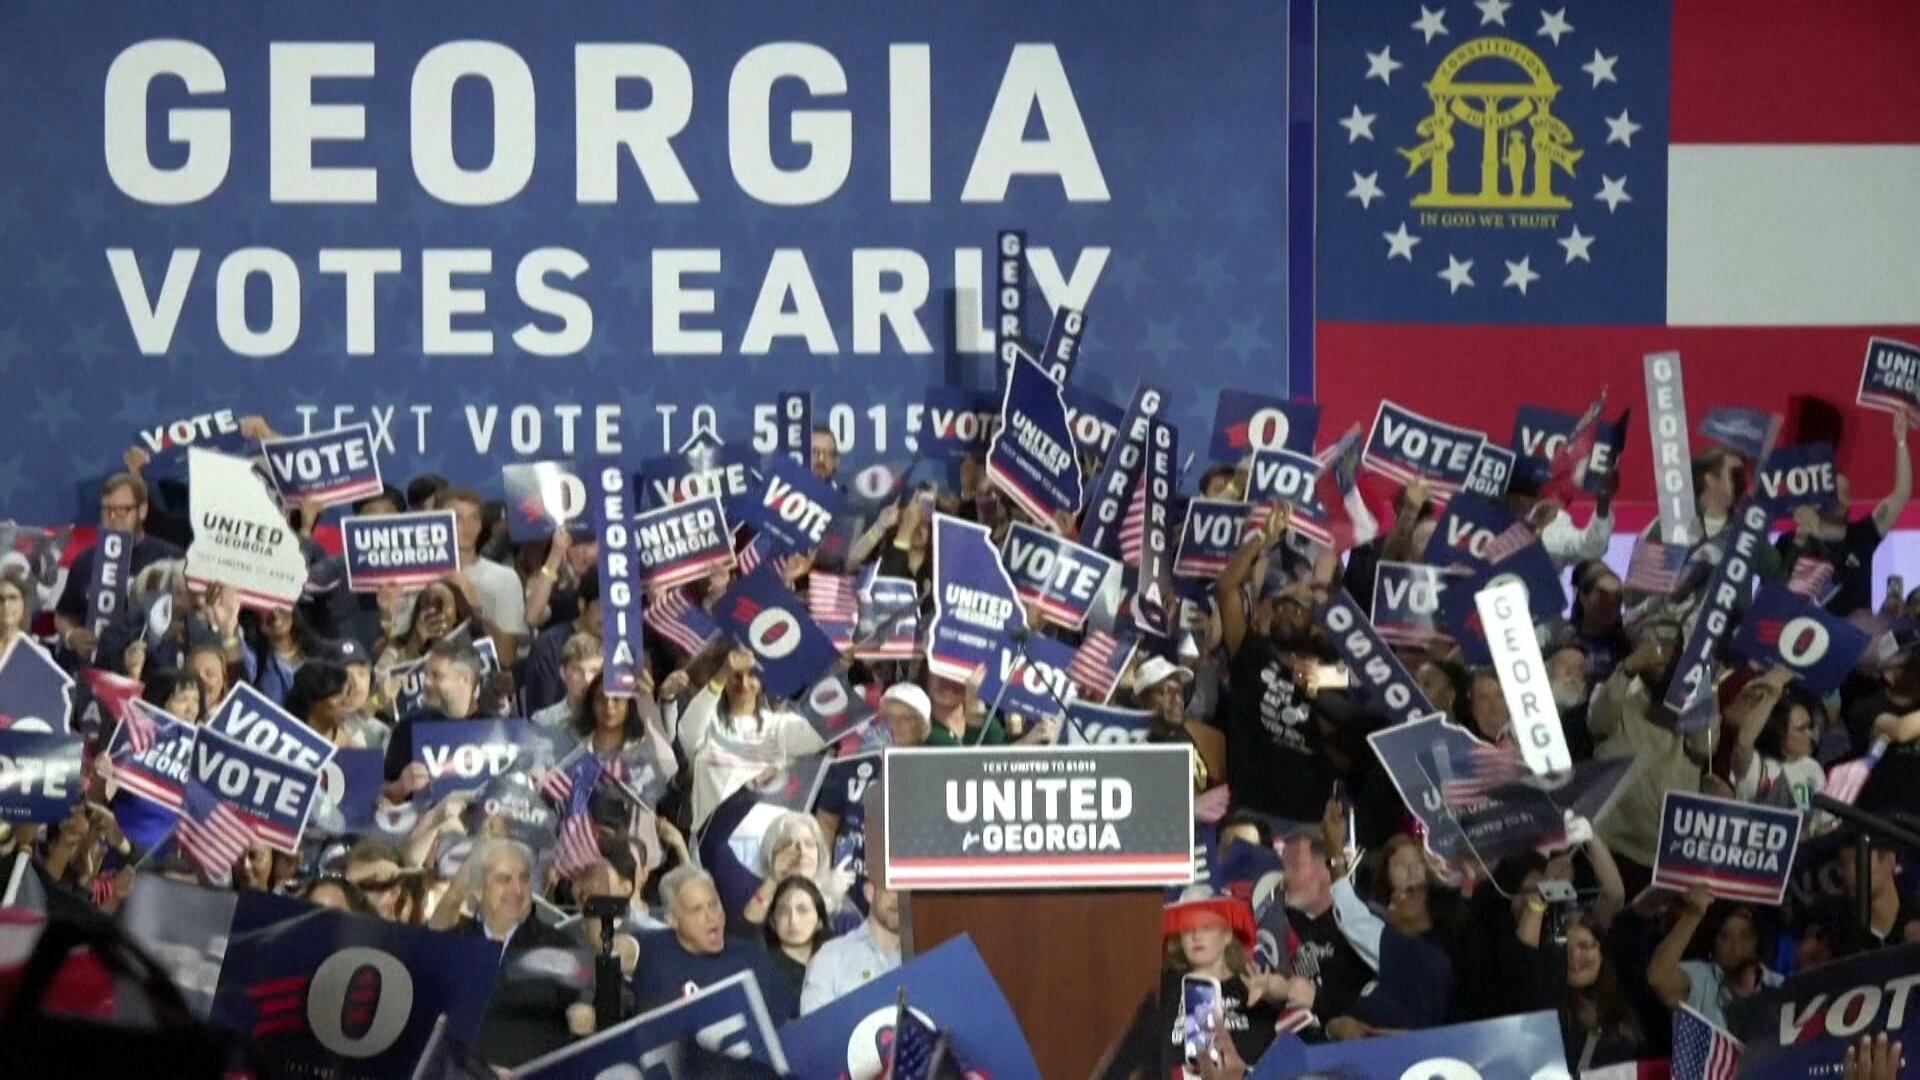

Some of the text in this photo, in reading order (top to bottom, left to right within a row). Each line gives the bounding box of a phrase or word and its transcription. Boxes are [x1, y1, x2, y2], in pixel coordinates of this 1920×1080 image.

[1441, 40, 1542, 78] CONSTITUTION
[104, 38, 1110, 205] GEORGIA
[1420, 212, 1559, 228] IN GOD WE TRUST
[106, 247, 1110, 356] VOTES EARLY
[1877, 349, 1920, 376] UNI
[141, 409, 238, 453] VOTE
[465, 404, 623, 454] VOTE
[753, 403, 925, 454] 5015
[1011, 409, 1071, 472] UNITED
[1382, 415, 1473, 471] VOTE
[1521, 426, 1611, 473] VOE
[1653, 358, 1689, 544] GEORGIA
[271, 438, 369, 482] VOTE
[1760, 462, 1835, 499] VOTE
[653, 464, 747, 506] VOTE
[1255, 461, 1325, 513] VOT
[203, 512, 283, 546] UNITED
[763, 475, 832, 543] VOTE
[1151, 426, 1172, 608] GEORGIA
[354, 523, 448, 551] UNITED
[367, 545, 449, 567] GEORGIA
[601, 467, 634, 666] GEORGIA
[1009, 537, 1101, 600] VOTE
[946, 582, 1013, 621] UNITED
[1383, 577, 1447, 614] VO
[1683, 506, 1767, 690] GEORGIA
[225, 699, 321, 771] VOTE
[198, 742, 306, 817] VOTE
[1010, 760, 1049, 773] UNITED
[946, 777, 1132, 823] UNITED
[982, 823, 1121, 853] GEORGIA
[1673, 806, 1788, 852] UNITED
[1682, 837, 1779, 873] GEORGIA
